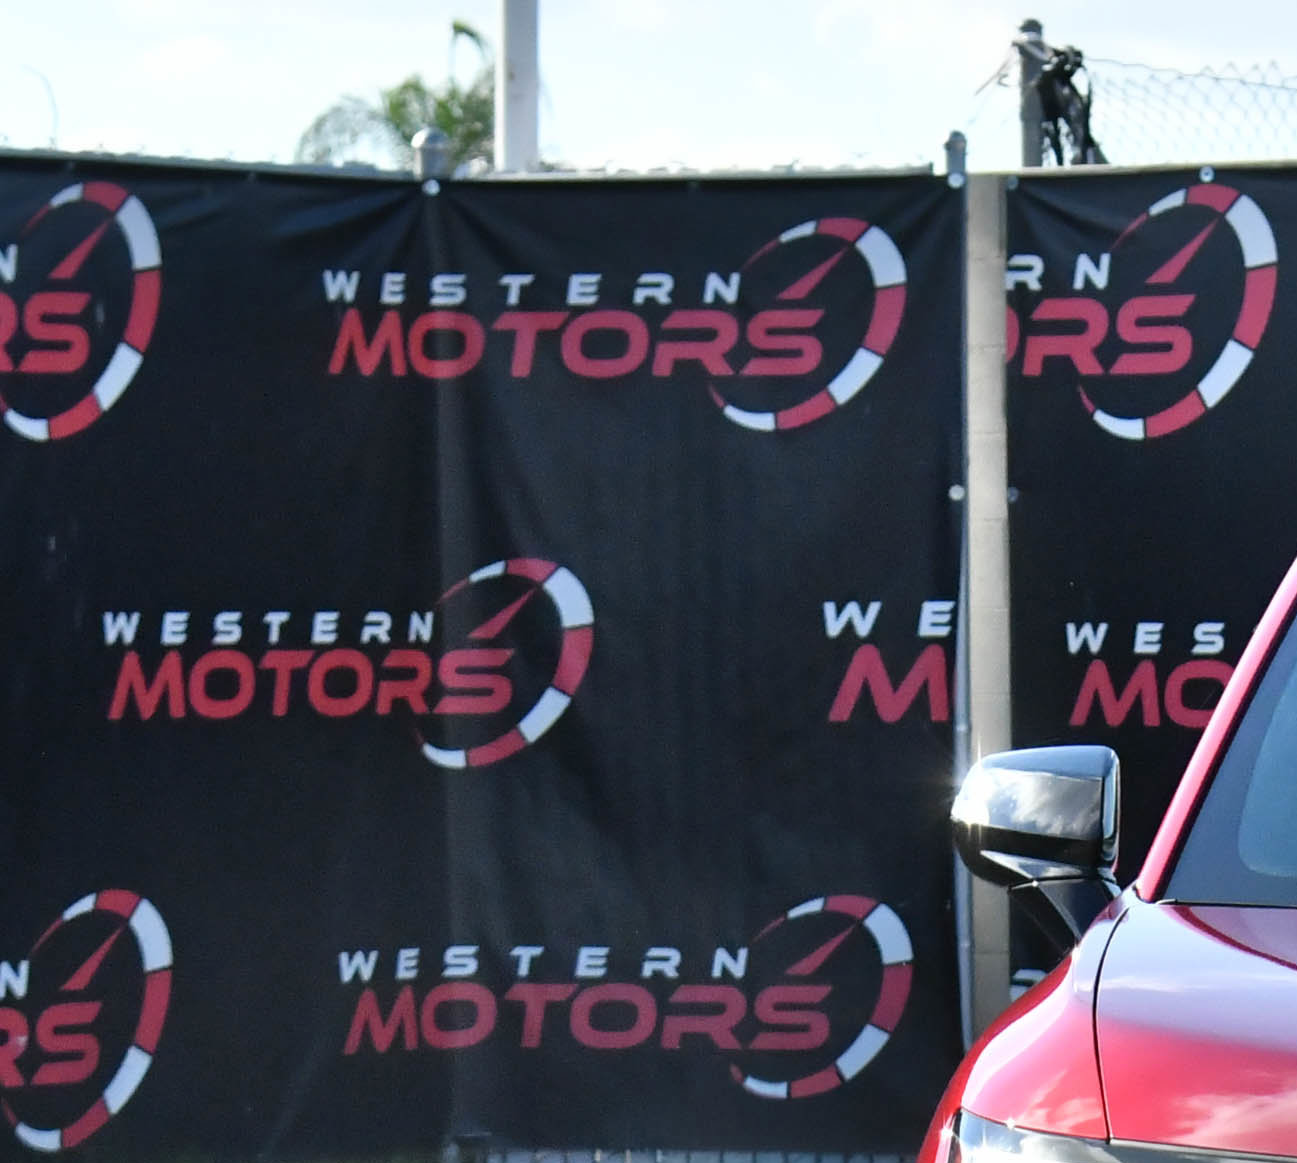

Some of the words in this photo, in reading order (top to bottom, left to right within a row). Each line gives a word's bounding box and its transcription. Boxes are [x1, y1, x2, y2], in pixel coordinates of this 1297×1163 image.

[323, 270, 741, 306] WESTERN
[329, 308, 824, 379] MOTORS
[103, 611, 434, 645] WESTERN
[108, 648, 513, 721] MOTORS
[339, 945, 748, 983] WESTERN
[346, 983, 832, 1054] MOTORS
